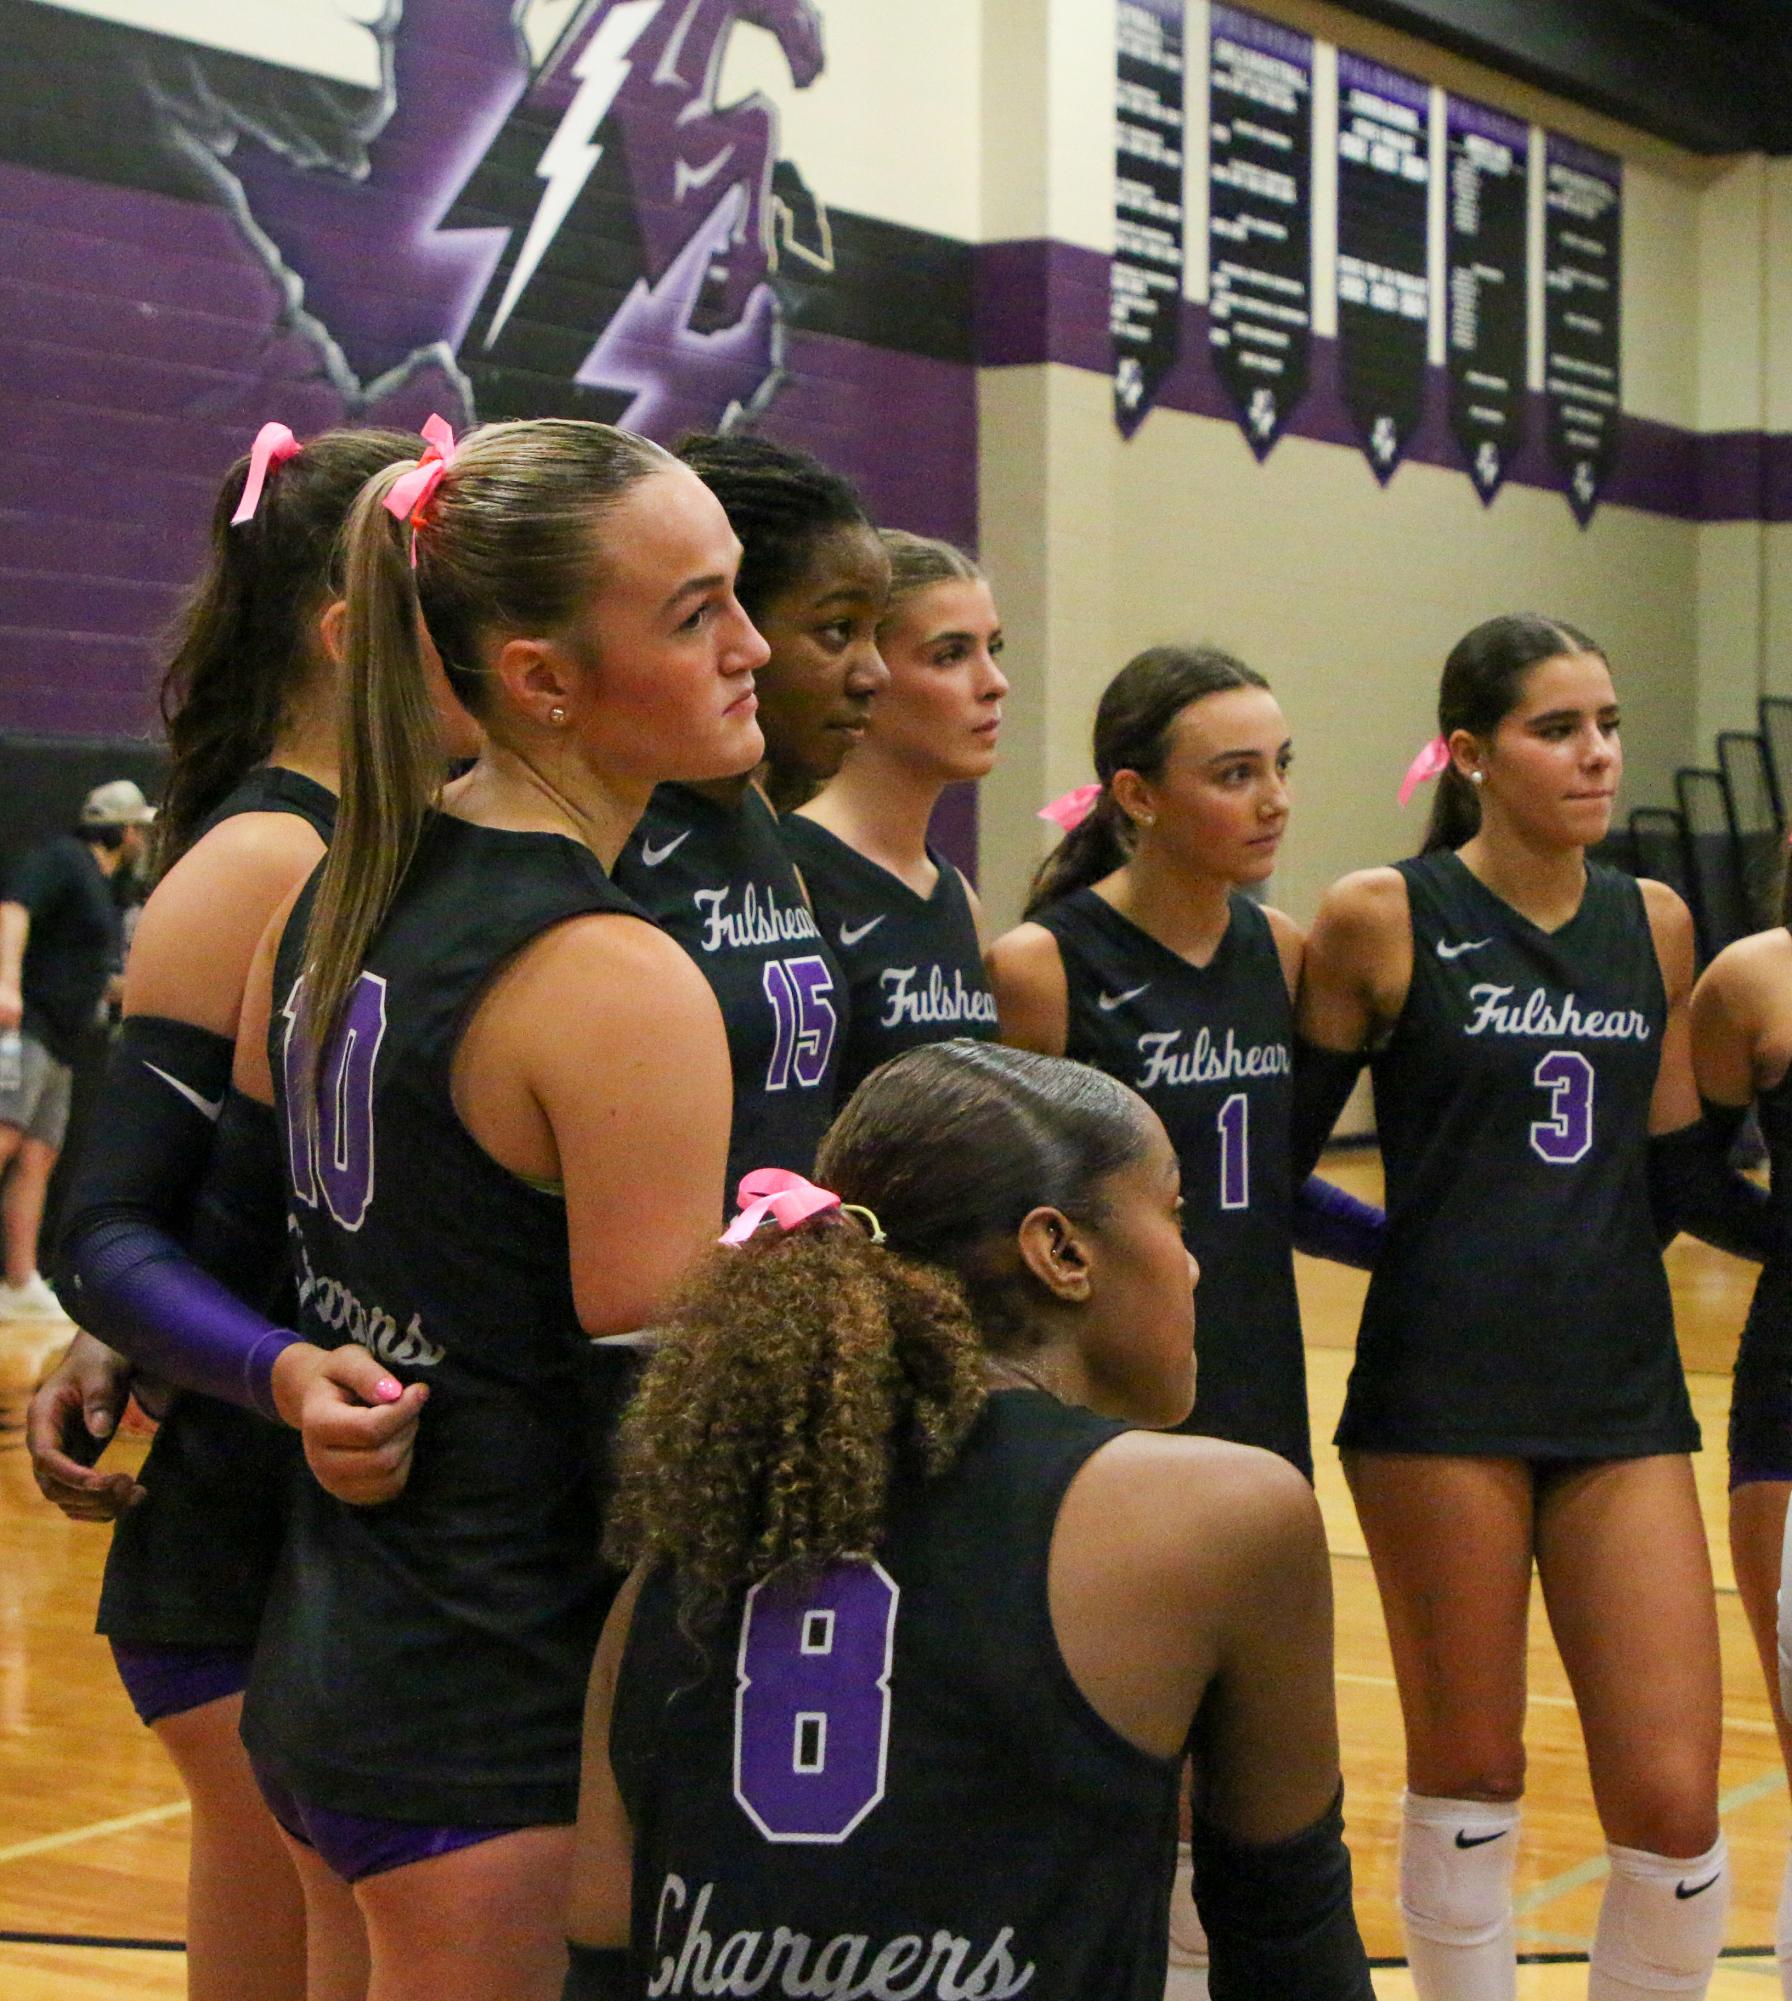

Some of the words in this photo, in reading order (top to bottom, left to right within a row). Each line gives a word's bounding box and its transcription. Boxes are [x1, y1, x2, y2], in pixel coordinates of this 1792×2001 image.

[763, 955, 837, 1091] 15
[880, 964, 998, 1028] Fulshea
[1464, 983, 1650, 1039] Fulshear
[282, 962, 388, 1232] 10
[1136, 1027, 1291, 1089] Fulshear
[1530, 1050, 1594, 1164] 3
[1218, 1093, 1249, 1209] 1
[733, 1551, 900, 1843] 8
[648, 1873, 1036, 2001] Chargers
